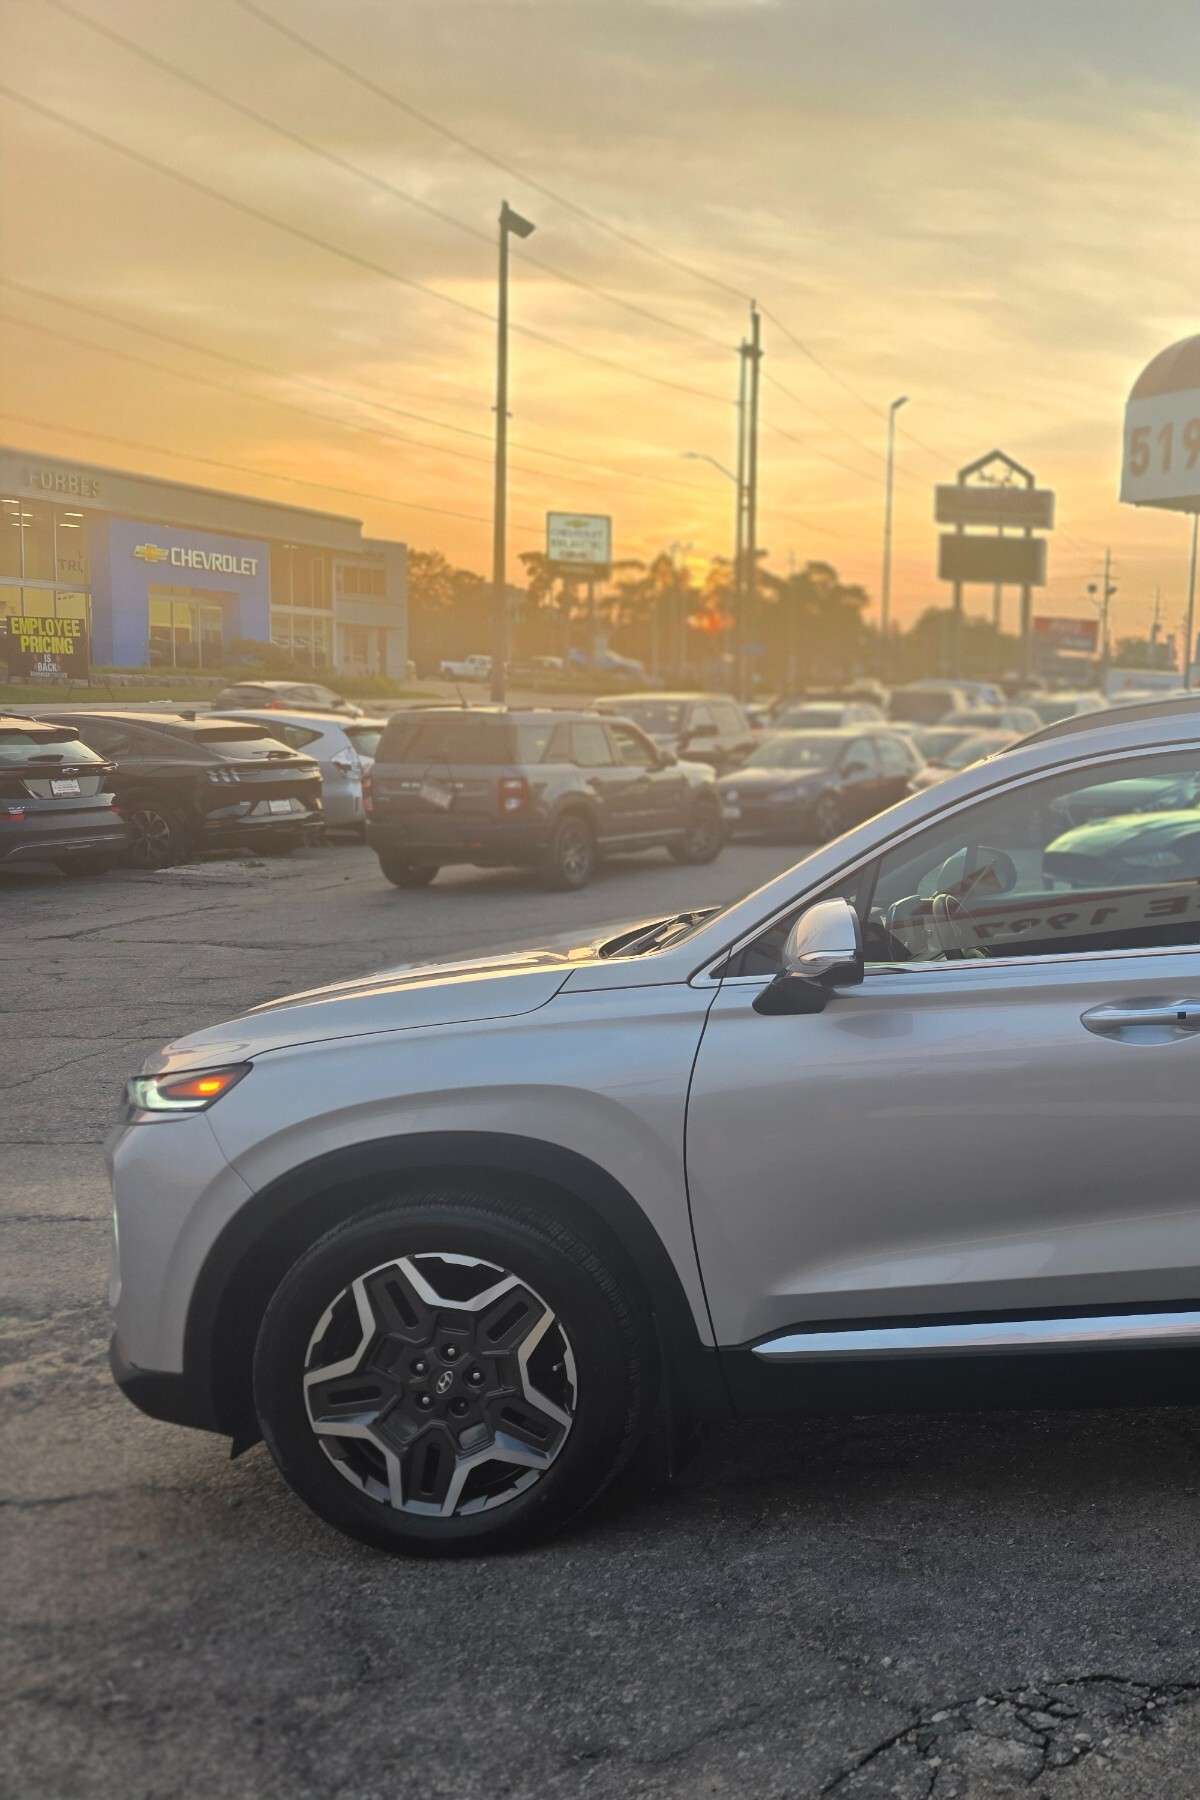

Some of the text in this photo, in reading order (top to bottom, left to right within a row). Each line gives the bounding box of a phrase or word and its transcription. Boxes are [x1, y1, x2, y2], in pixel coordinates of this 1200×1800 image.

[171, 546, 258, 576] CHEVROLET
[10, 617, 81, 637] EMPLOYEE
[20, 635, 74, 655] PRICING
[43, 653, 52, 662] IS
